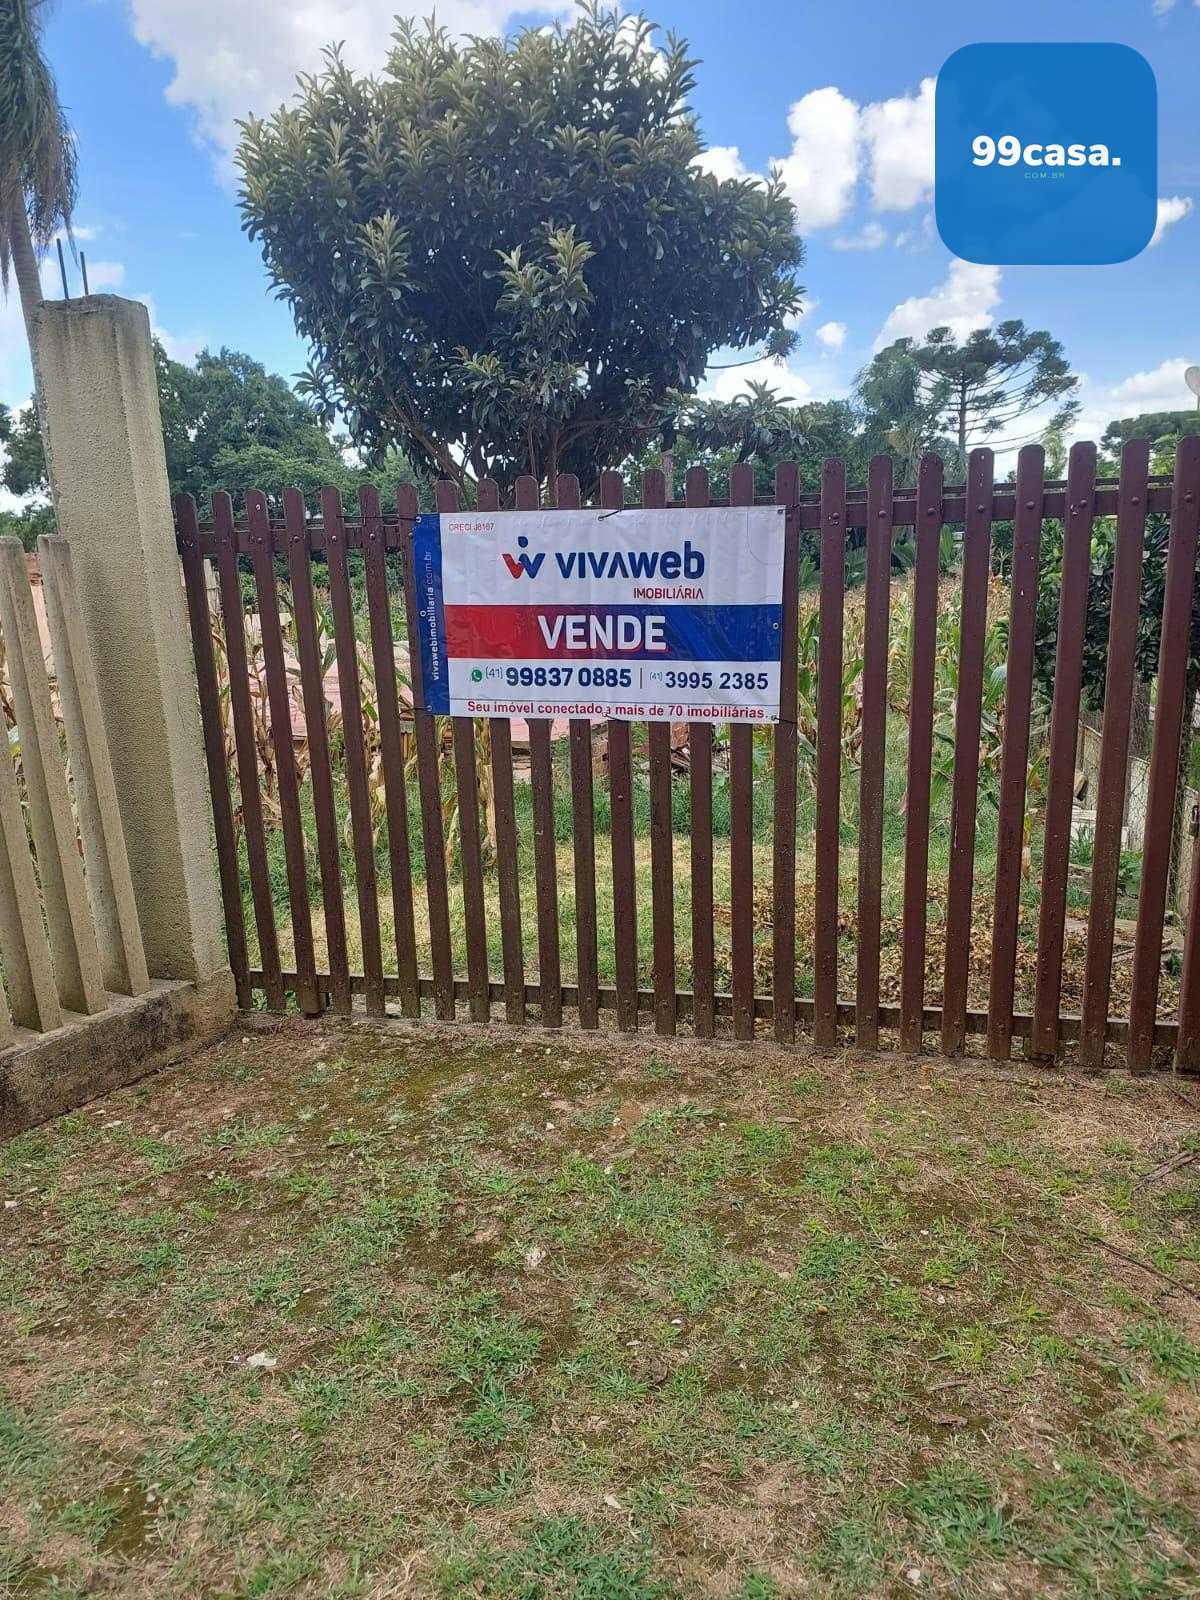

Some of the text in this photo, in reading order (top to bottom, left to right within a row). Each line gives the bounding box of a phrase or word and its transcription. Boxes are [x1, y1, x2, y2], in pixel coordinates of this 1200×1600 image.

[448, 523, 471, 531] CRECI
[633, 585, 704, 599] IMOBILIÁRIA
[537, 614, 667, 650] VENDE
[485, 667, 504, 680] (41)
[649, 671, 769, 690] (41) 3995 2385
[467, 701, 490, 712] Seu
[494, 701, 534, 714] imóvel
[538, 702, 603, 714] conectado
[615, 705, 645, 716] mais
[648, 704, 664, 716] de
[668, 705, 683, 717] 70
[687, 705, 768, 719] imobiliárias.
